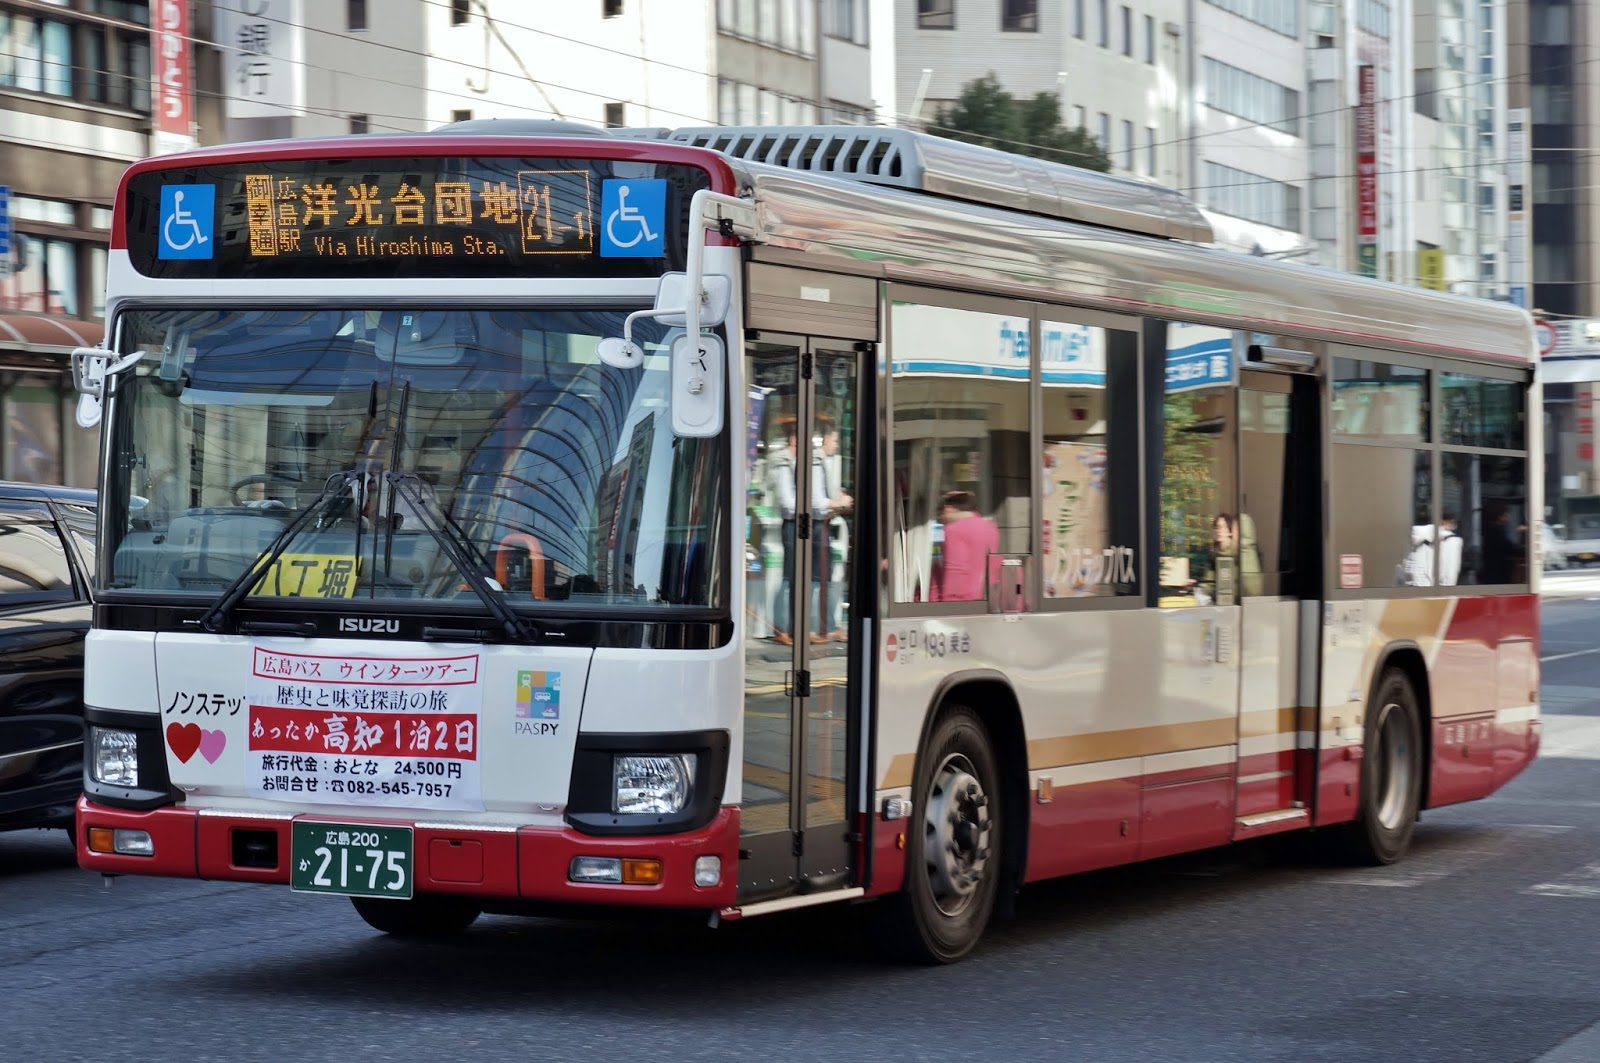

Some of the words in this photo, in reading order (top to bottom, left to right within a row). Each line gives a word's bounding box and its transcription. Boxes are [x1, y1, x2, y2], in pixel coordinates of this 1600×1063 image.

[277, 177, 301, 252] 広島駅
[301, 182, 518, 226] 洋光台団地
[314, 236, 347, 255] Via
[356, 235, 454, 256] Hiroshima
[464, 235, 505, 255] Sta.
[252, 558, 354, 598] 八丁堀
[339, 618, 400, 633] ISUZU
[262, 656, 321, 677] 広島バス
[339, 662, 468, 681] ウインターツアー
[165, 691, 246, 716] ノンステッ
[276, 684, 448, 711] 歴史と味覚探訪の旅
[515, 721, 559, 736] PASPY
[394, 761, 462, 779] 24,500円
[347, 780, 452, 798] 082-545-7957
[299, 858, 311, 872] か
[313, 846, 406, 891] 21-75
